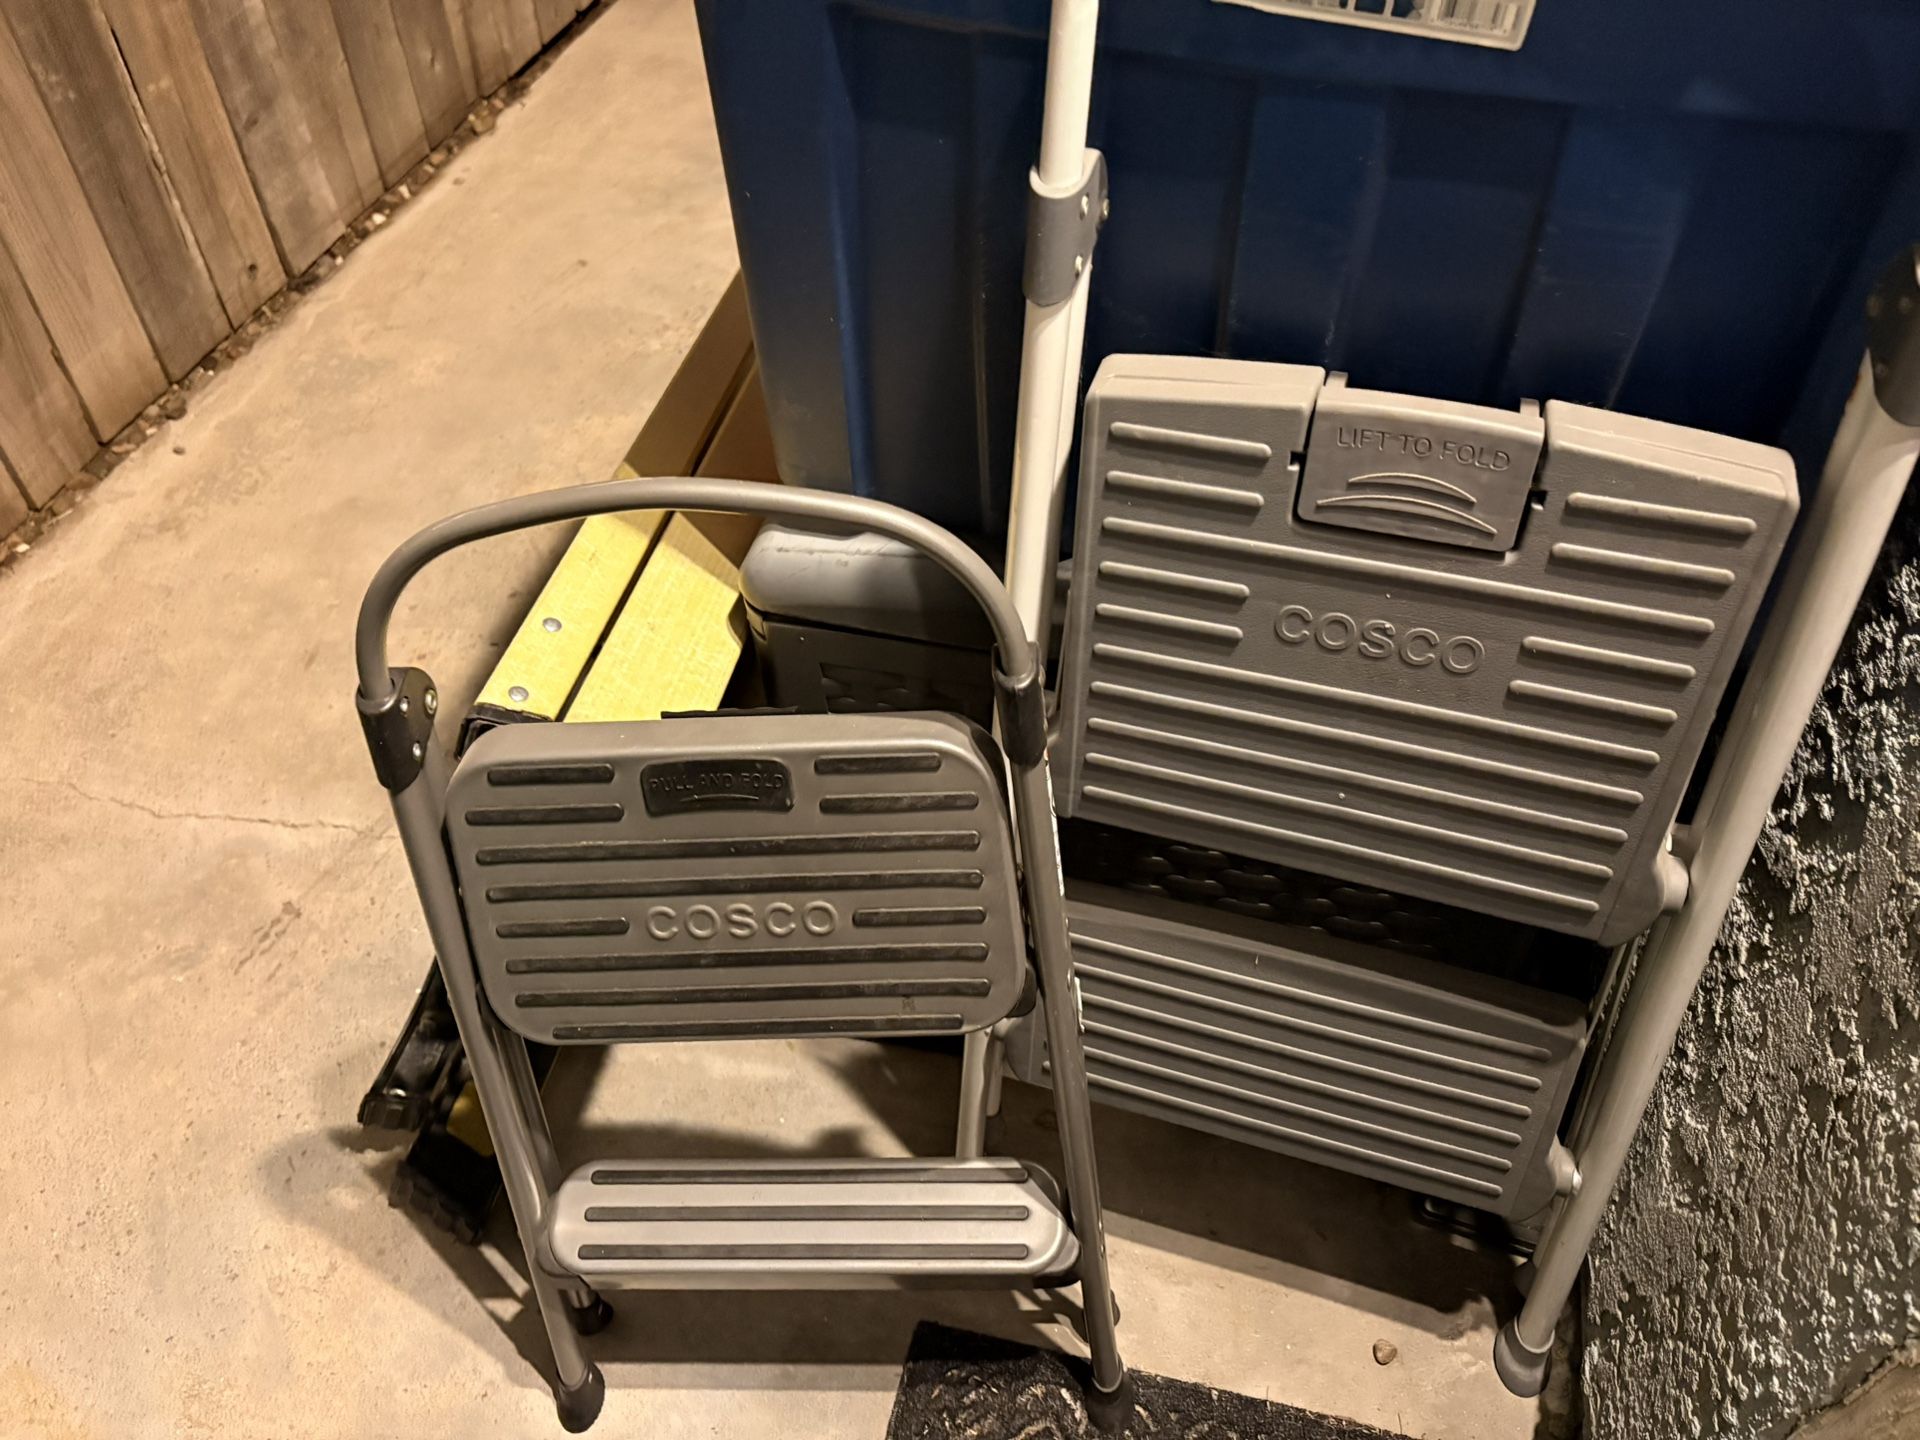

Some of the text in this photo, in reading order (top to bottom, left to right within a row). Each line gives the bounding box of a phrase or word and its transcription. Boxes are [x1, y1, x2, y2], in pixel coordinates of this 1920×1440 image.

[1336, 426, 1511, 471] LIFT TO FOLD
[1275, 604, 1485, 674] COSCO
[650, 773, 784, 791] PULL AND FOLD
[647, 900, 839, 941] COSCO
